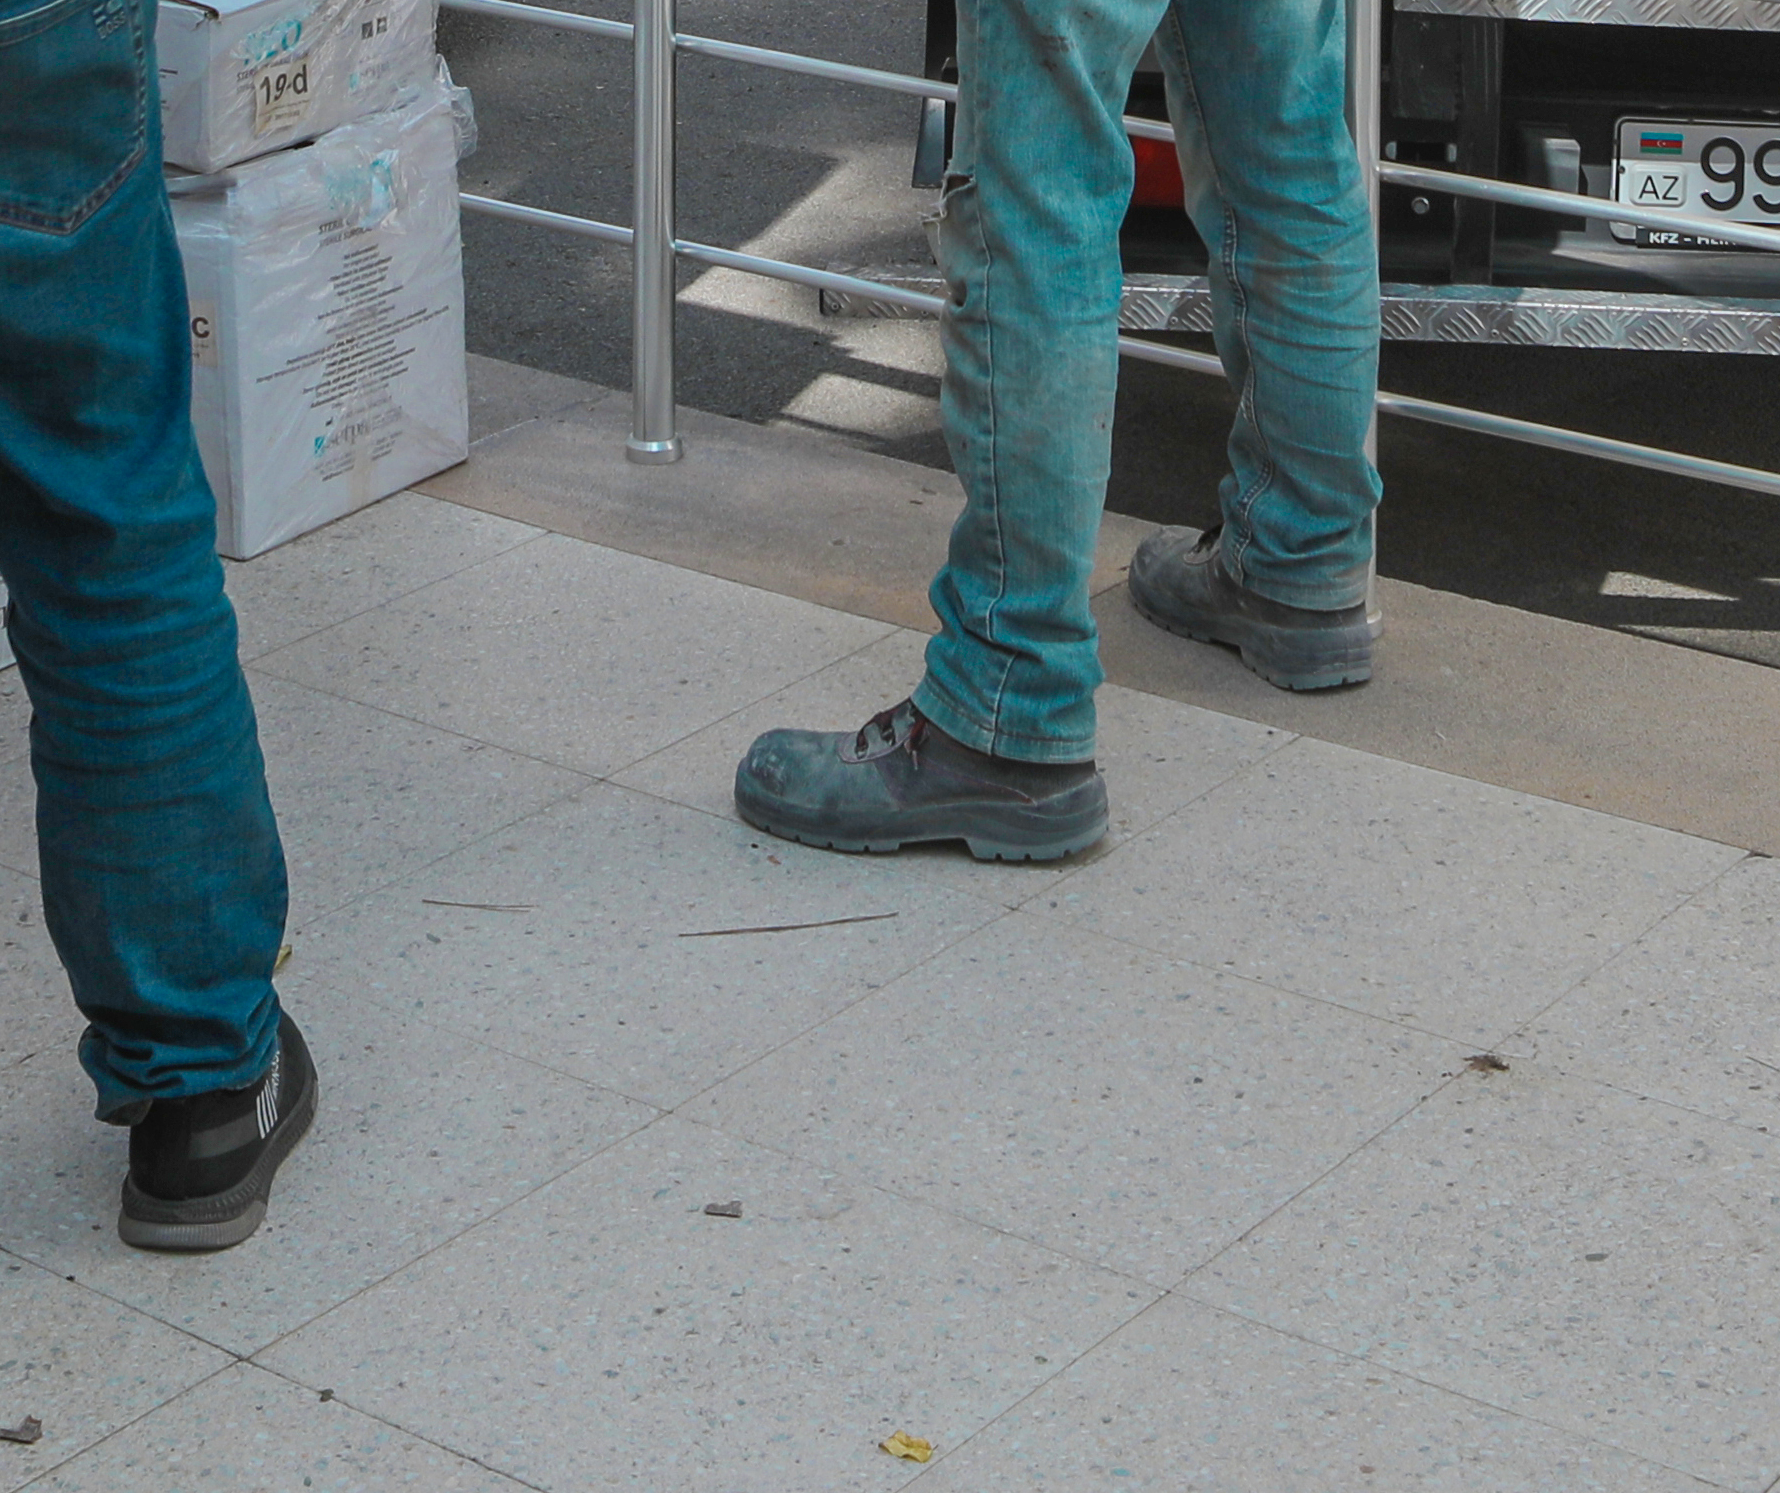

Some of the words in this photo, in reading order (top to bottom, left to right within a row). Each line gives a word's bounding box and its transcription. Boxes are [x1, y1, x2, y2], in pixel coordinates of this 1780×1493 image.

[259, 64, 309, 106] 19-d
[1638, 174, 1680, 202] AZ
[1649, 231, 1680, 246] KFZ
